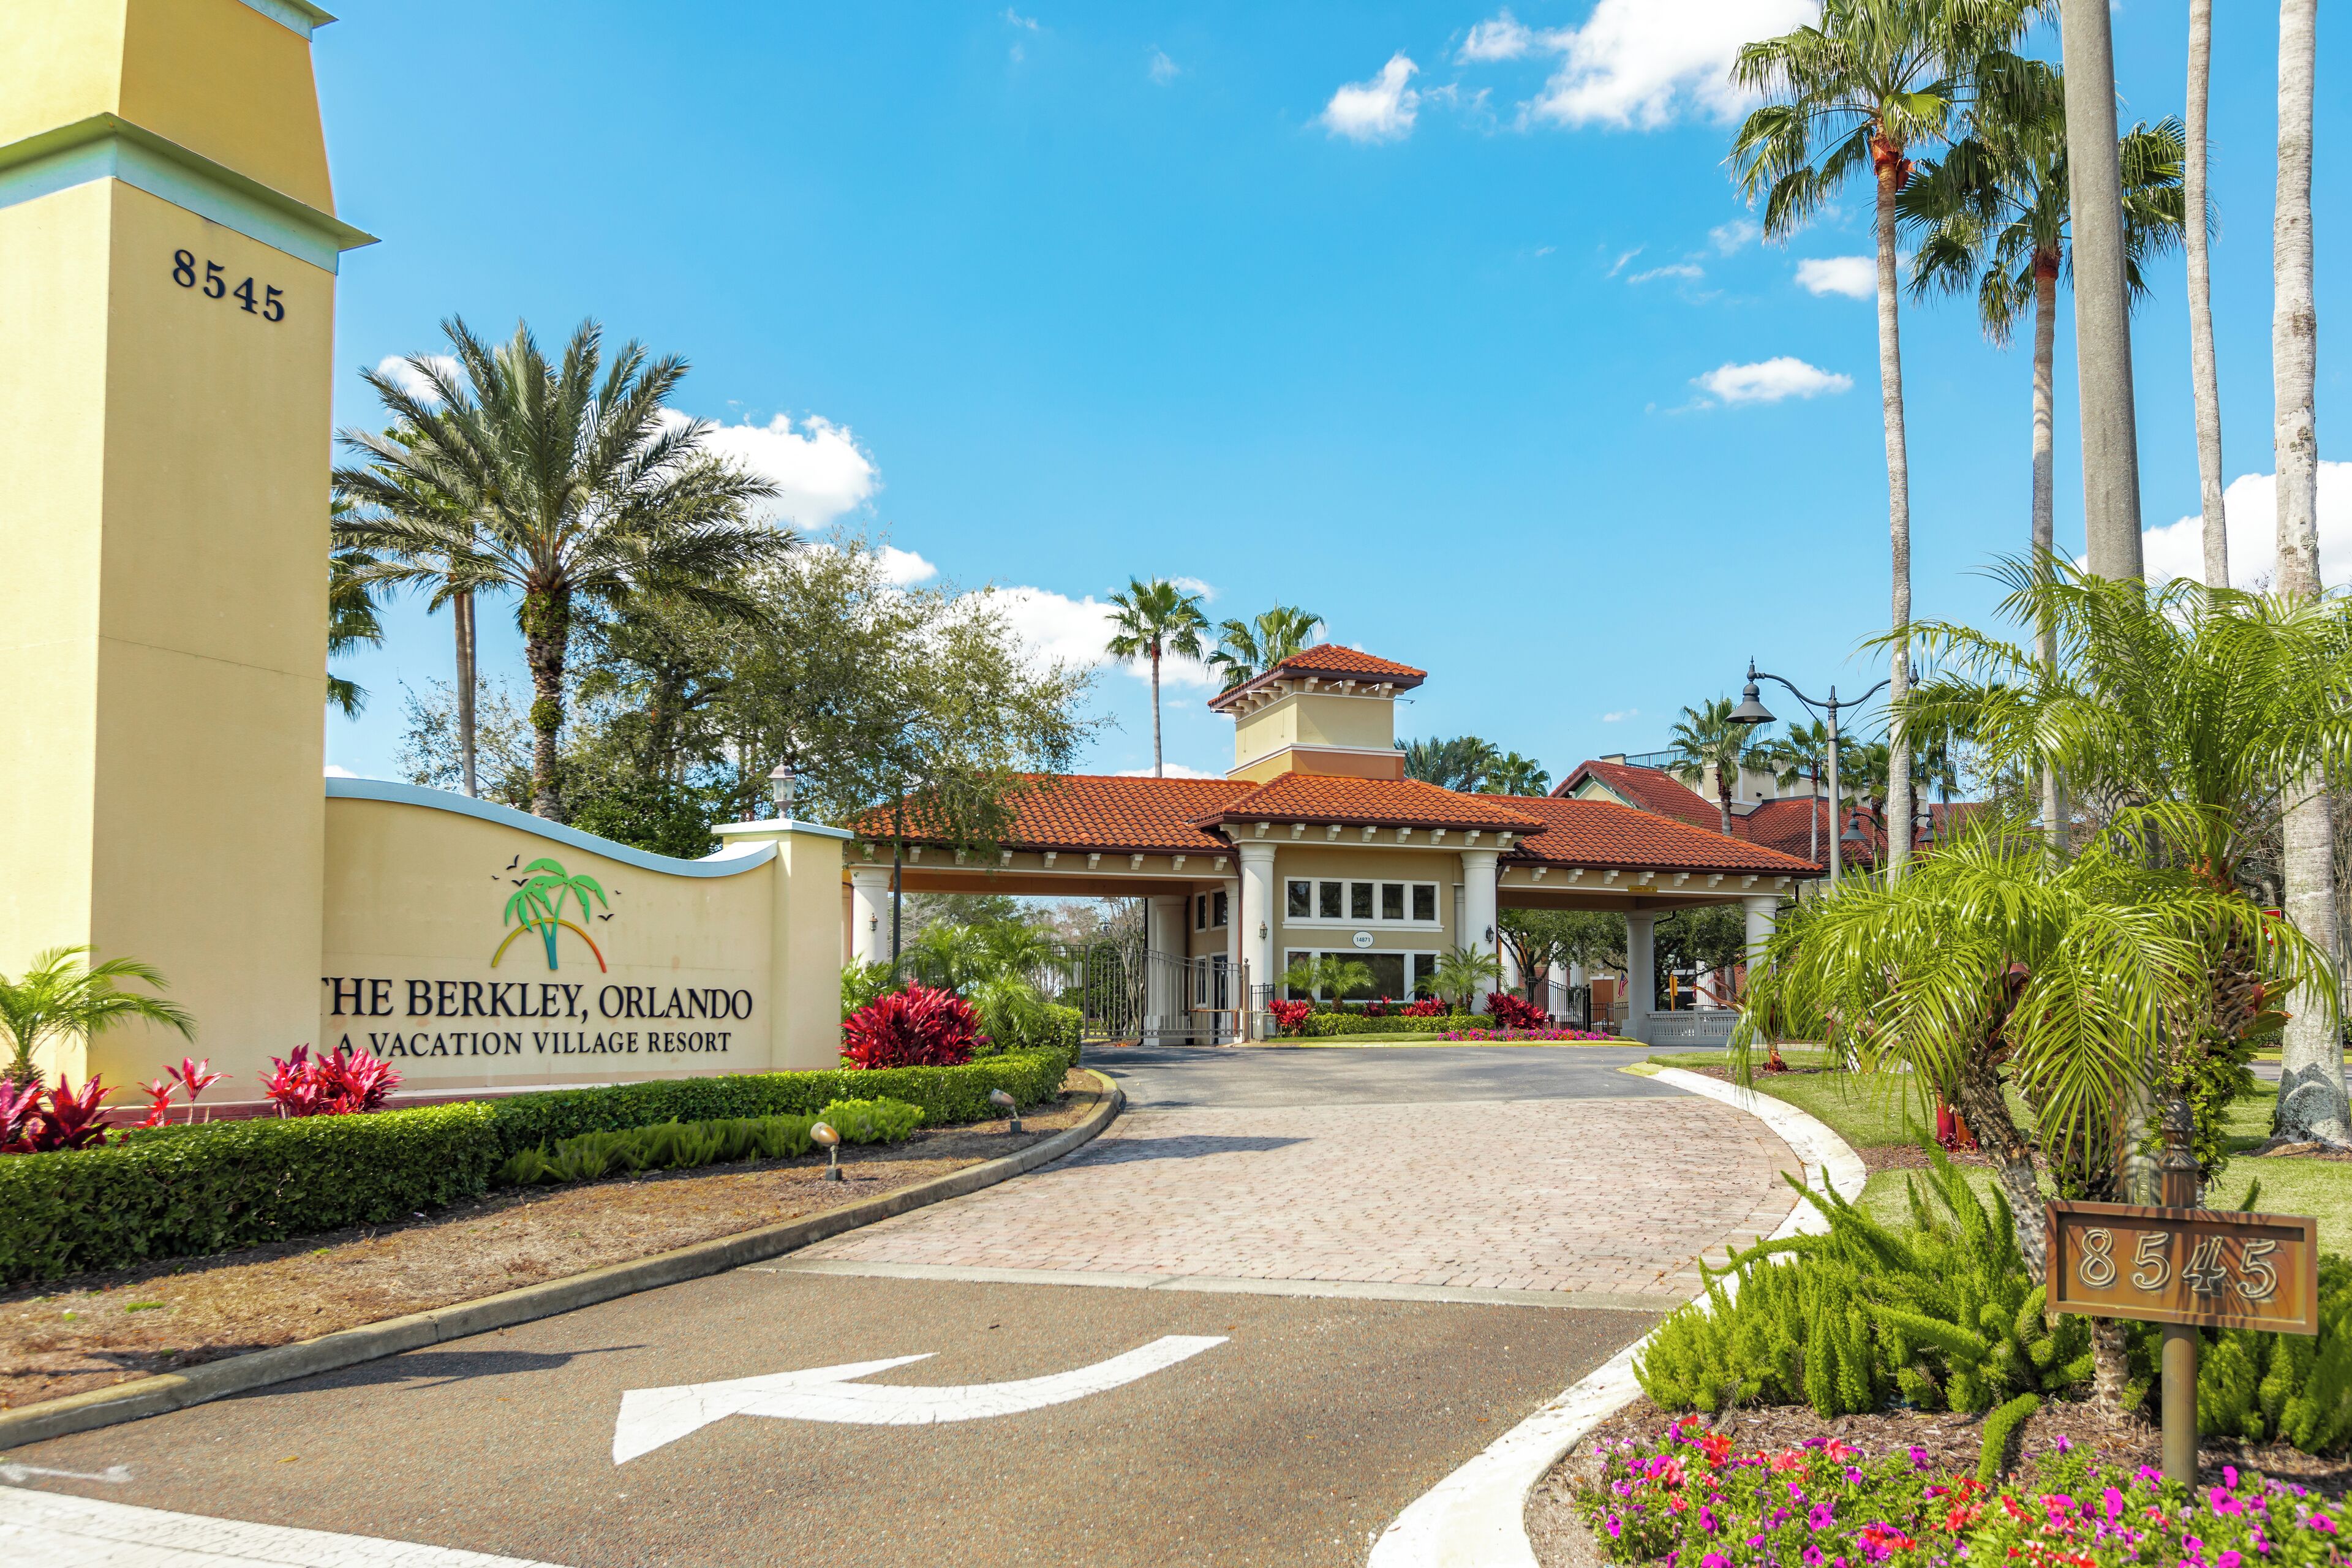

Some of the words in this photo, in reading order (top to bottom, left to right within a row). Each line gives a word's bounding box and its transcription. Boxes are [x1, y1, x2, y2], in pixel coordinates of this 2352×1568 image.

[173, 249, 285, 322] 8545
[405, 979, 588, 1024] BERKLEY,
[599, 985, 753, 1019] ORLANDO
[339, 1033, 354, 1057] A
[368, 1032, 523, 1057] VACATION
[532, 1031, 639, 1054] VILLAGE
[647, 1031, 732, 1053] RESORT
[2079, 1228, 2277, 1300] 8545
